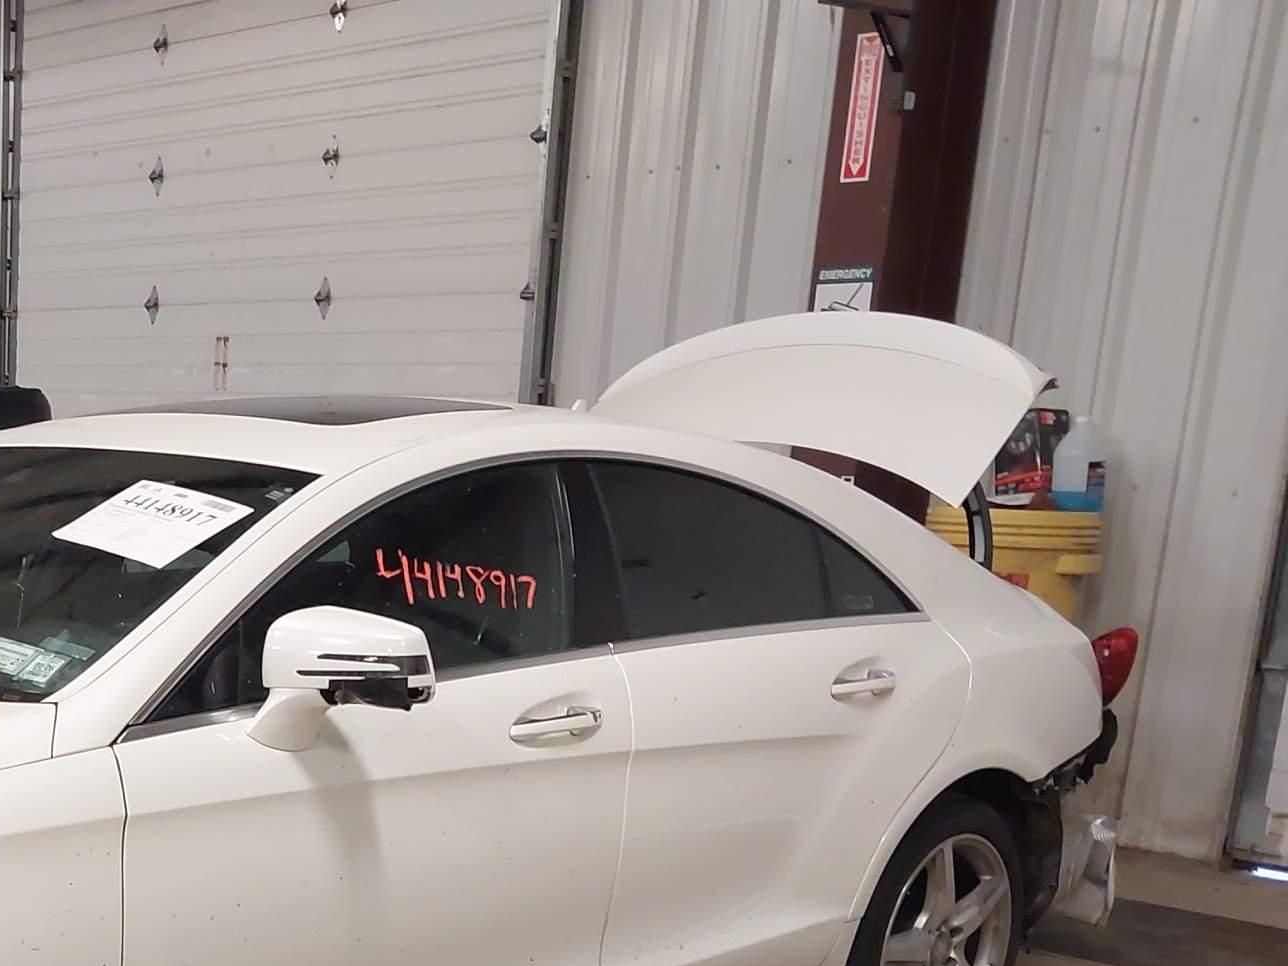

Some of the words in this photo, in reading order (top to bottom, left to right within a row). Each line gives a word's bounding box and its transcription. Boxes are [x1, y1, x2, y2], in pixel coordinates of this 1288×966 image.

[819, 267, 873, 280] EMERGENCY
[123, 495, 218, 526] 44148917
[376, 548, 536, 610] 44148917
